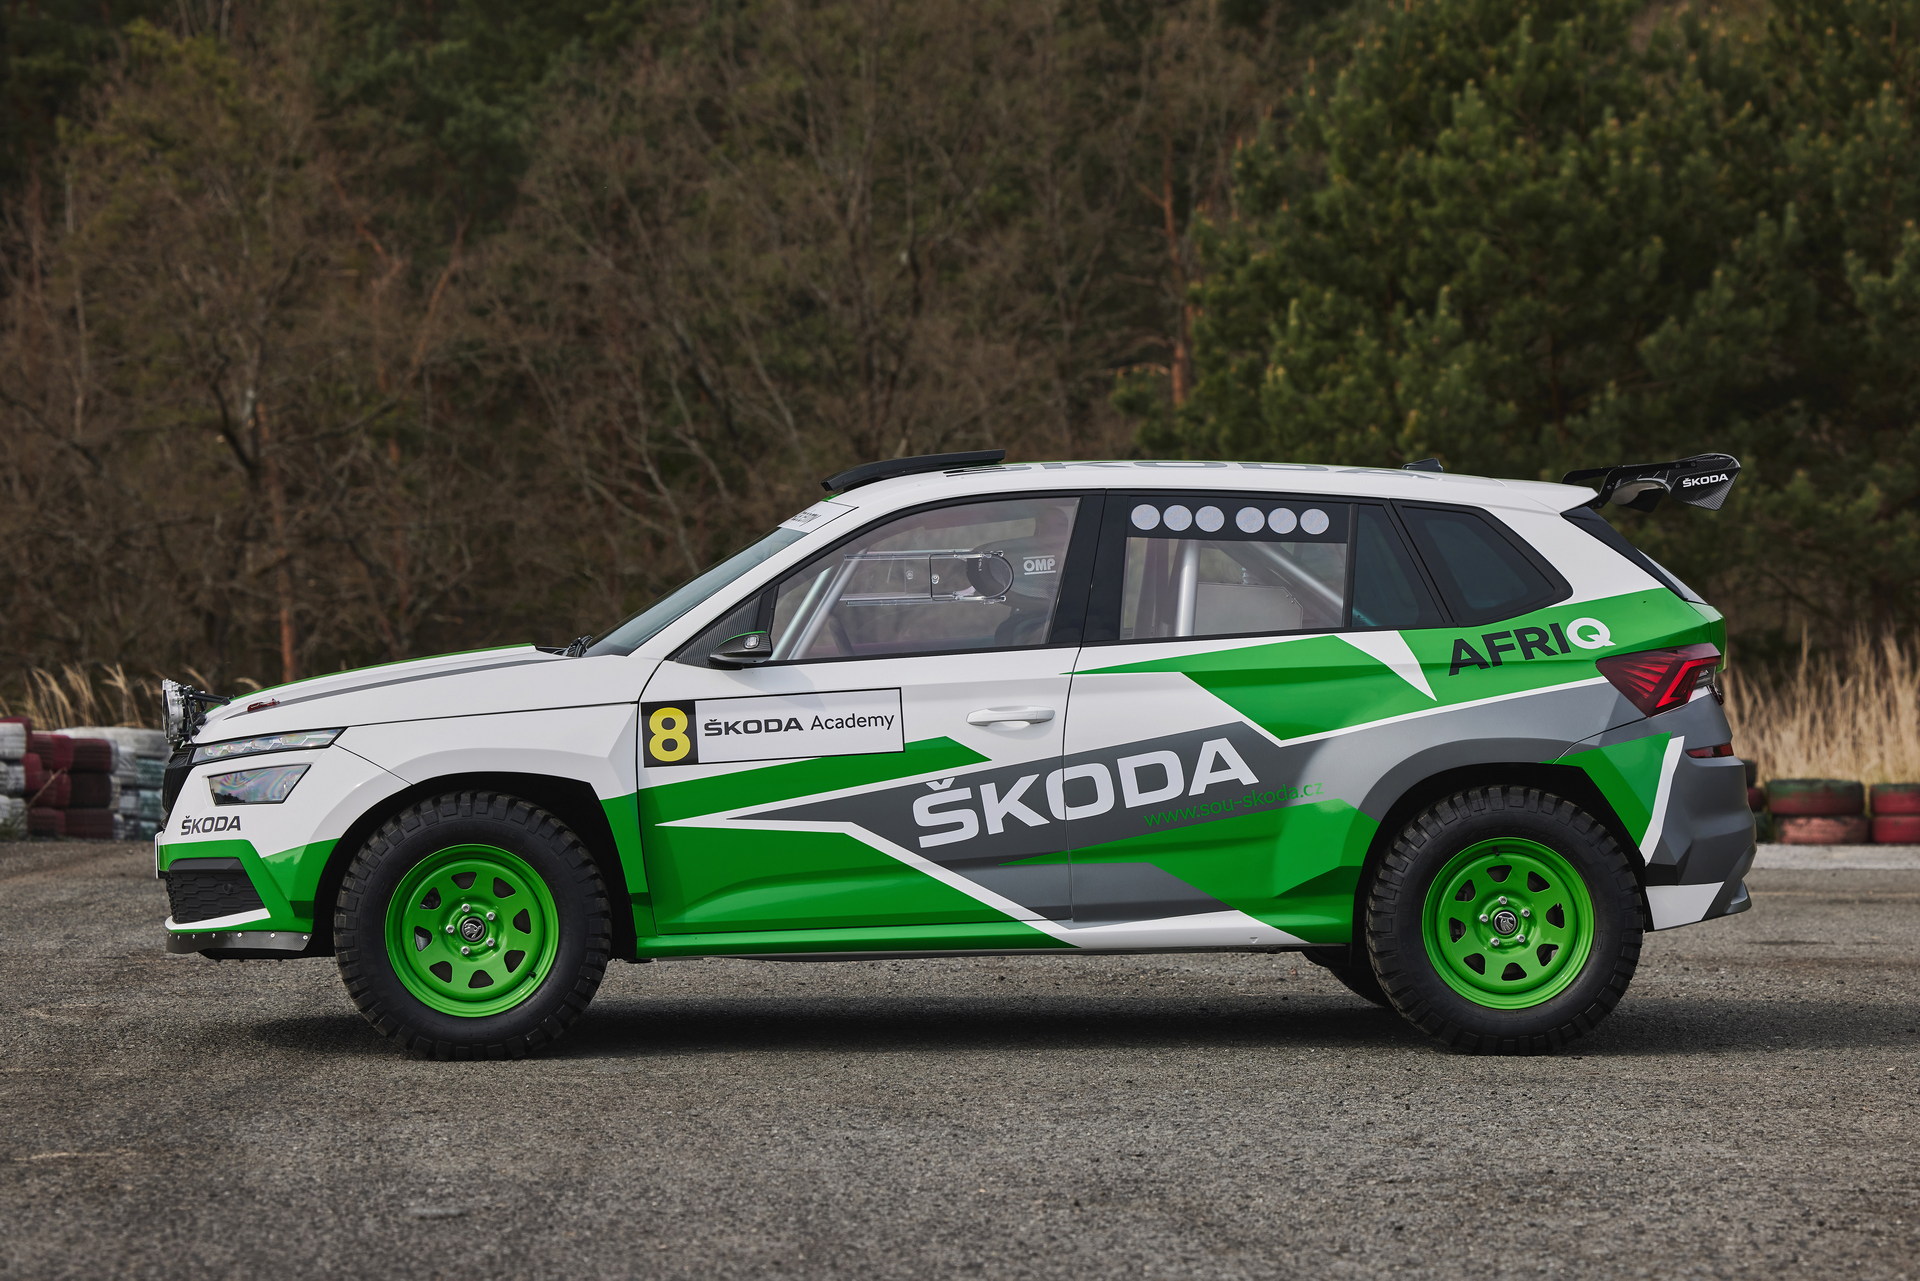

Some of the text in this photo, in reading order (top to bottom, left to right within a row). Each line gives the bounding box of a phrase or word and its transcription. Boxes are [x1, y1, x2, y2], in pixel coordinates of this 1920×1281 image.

[1682, 473, 1729, 488] ŠKODA
[1023, 558, 1056, 572] OMP
[1449, 617, 1616, 676] AFRIQ
[649, 707, 691, 762] 8
[704, 713, 895, 737] ŠKODA Academy
[912, 737, 1259, 848] ŠKODA
[1143, 782, 1325, 827] www.sou-skoda.cz
[181, 815, 241, 836] ŠKODA
